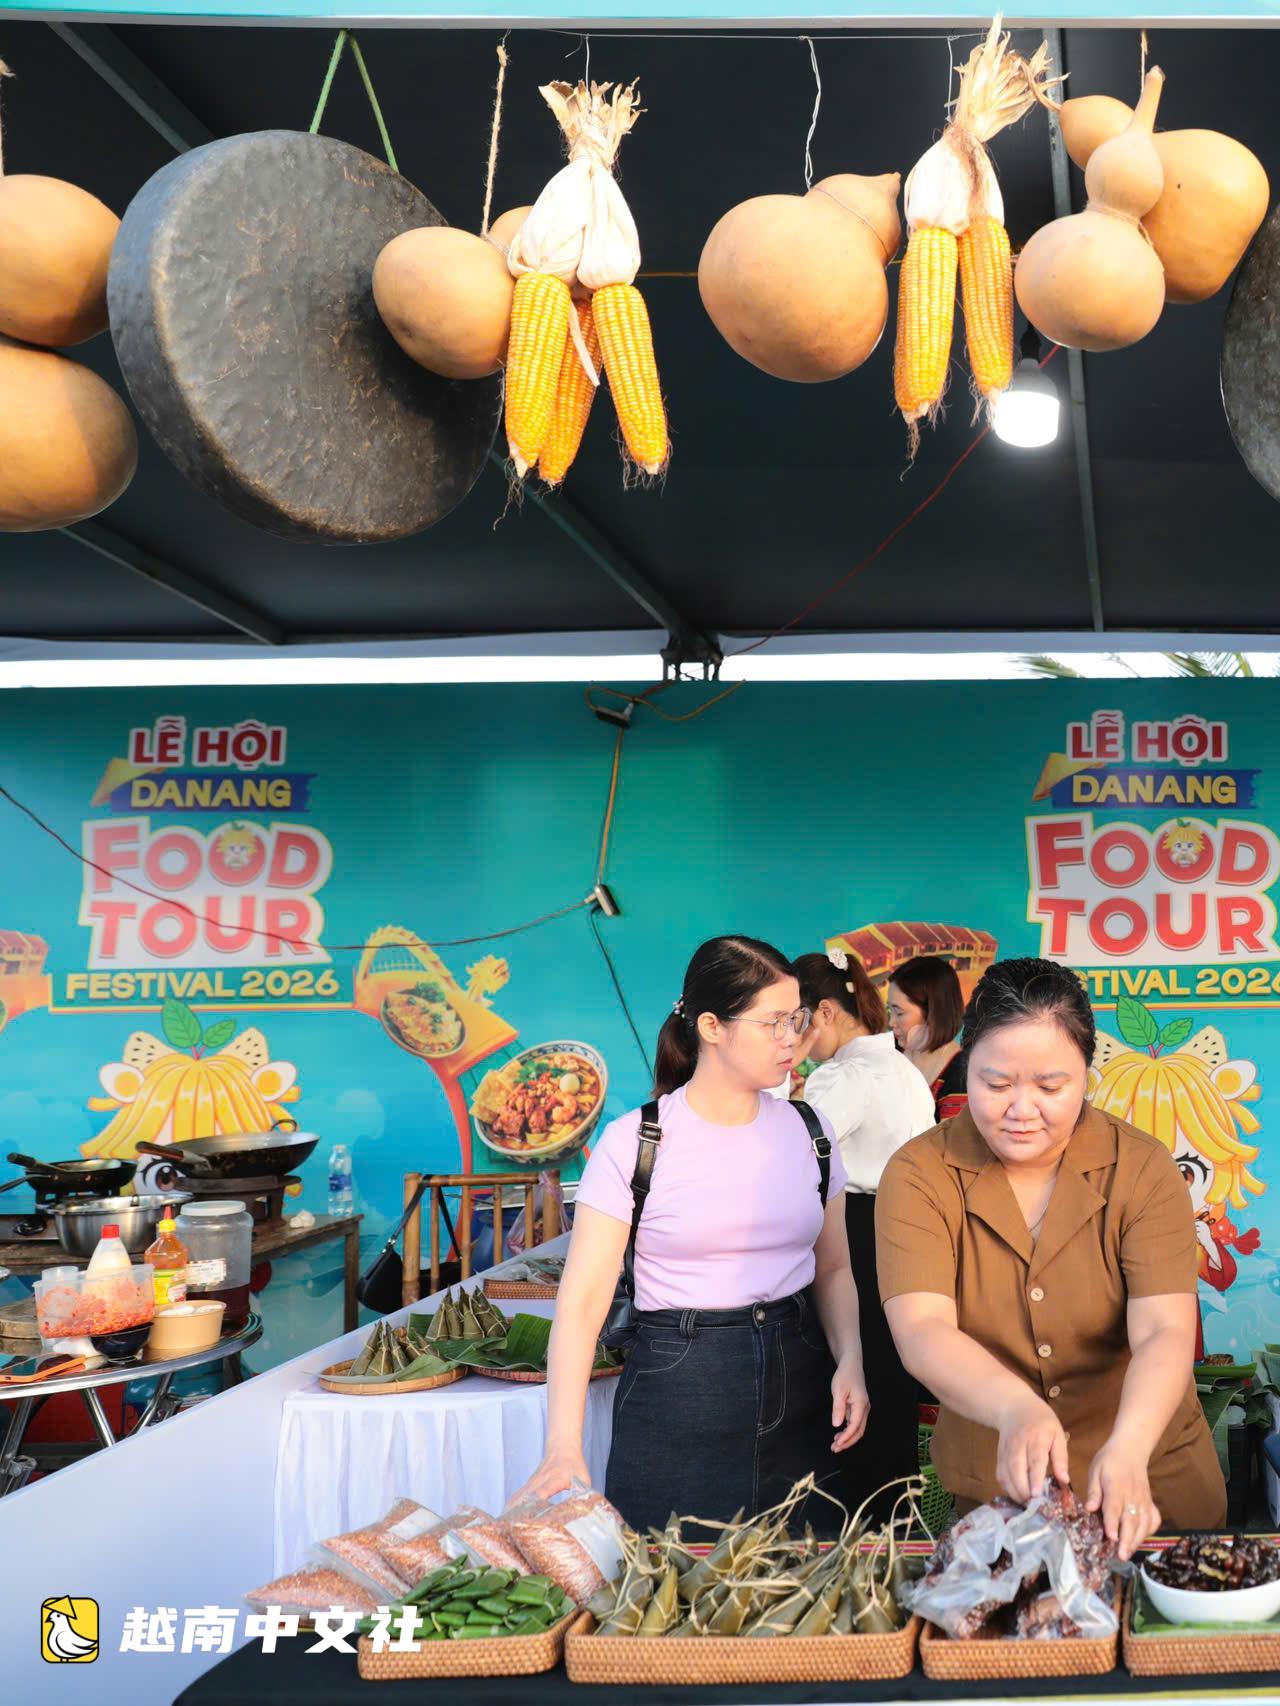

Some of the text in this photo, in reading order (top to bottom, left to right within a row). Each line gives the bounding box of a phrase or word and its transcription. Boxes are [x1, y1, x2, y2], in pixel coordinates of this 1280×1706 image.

[132, 717, 282, 767] LỄ HỘI
[1070, 712, 1224, 762] LỄ HỘI
[130, 780, 291, 807] DANANG
[1072, 775, 1237, 804] DANANG
[91, 824, 320, 893] FOOD
[1036, 821, 1270, 888] FOOD
[90, 896, 314, 958] TOUR
[1037, 893, 1265, 956] TOUR
[66, 969, 339, 1000] FESTIVAL 2026
